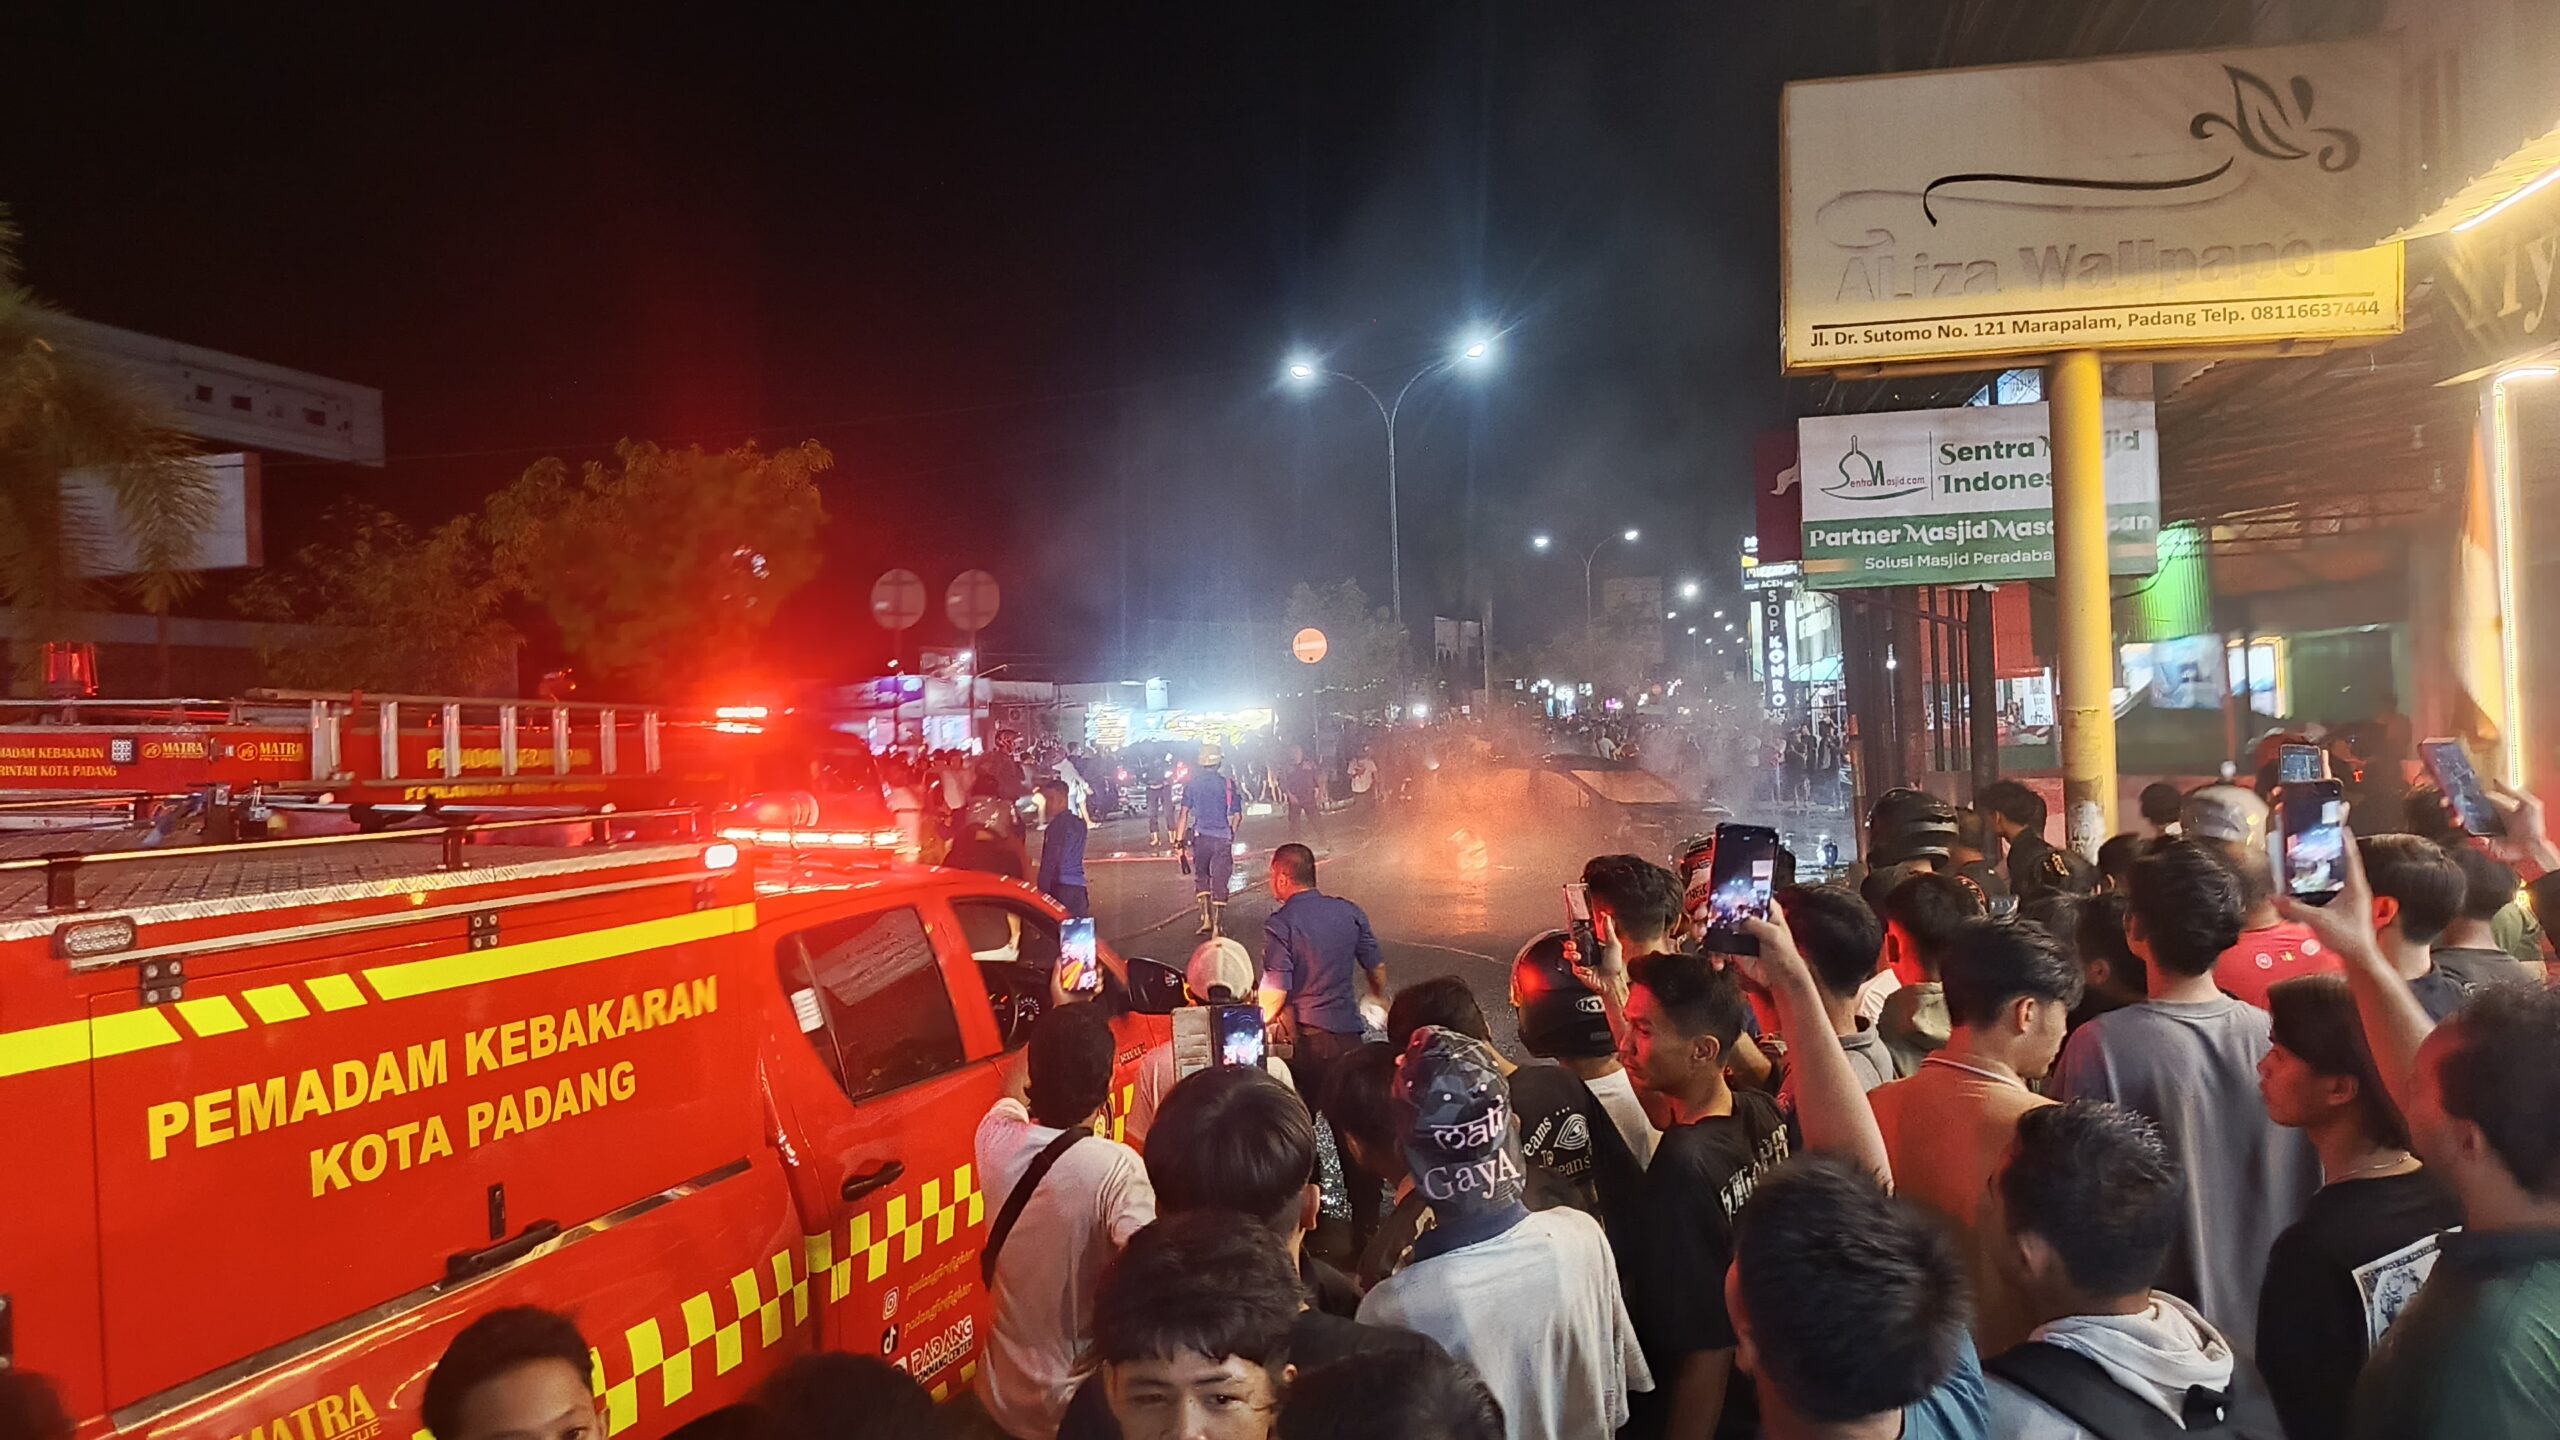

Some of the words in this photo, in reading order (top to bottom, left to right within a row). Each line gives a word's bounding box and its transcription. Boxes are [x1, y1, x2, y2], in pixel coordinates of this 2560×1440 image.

[1811, 331, 1829, 347] Jl.
[1834, 331, 1859, 345] Dr.
[1863, 325, 1932, 344] Sutomo
[1937, 324, 1968, 340] No.
[1974, 320, 2006, 337] 121
[2012, 315, 2122, 334] Marapalam,
[2128, 311, 2197, 329] Padang
[2201, 306, 2245, 325] Telp.
[2251, 299, 2380, 321] 08116637444
[1939, 440, 2035, 466] Sentra
[1809, 525, 1901, 548] Partner
[1903, 519, 1988, 546] Masjid
[1865, 556, 1914, 571] Solusi
[1917, 552, 1970, 571] Masjid
[1973, 549, 2053, 565] Peradaba
[1769, 636, 1787, 706] KONRO
[39, 747, 104, 759] KEBAKARAN
[162, 742, 204, 753] MATRA
[40, 765, 70, 777] KOTA
[73, 765, 118, 777] PADANG
[147, 1038, 448, 1160] PEMADAM
[464, 974, 718, 1077] KEBAKARAN
[309, 1116, 453, 1198] KOTA
[467, 1060, 636, 1148] PADANG
[911, 1314, 973, 1376] PADANG
[230, 1384, 376, 1440] ATRA
